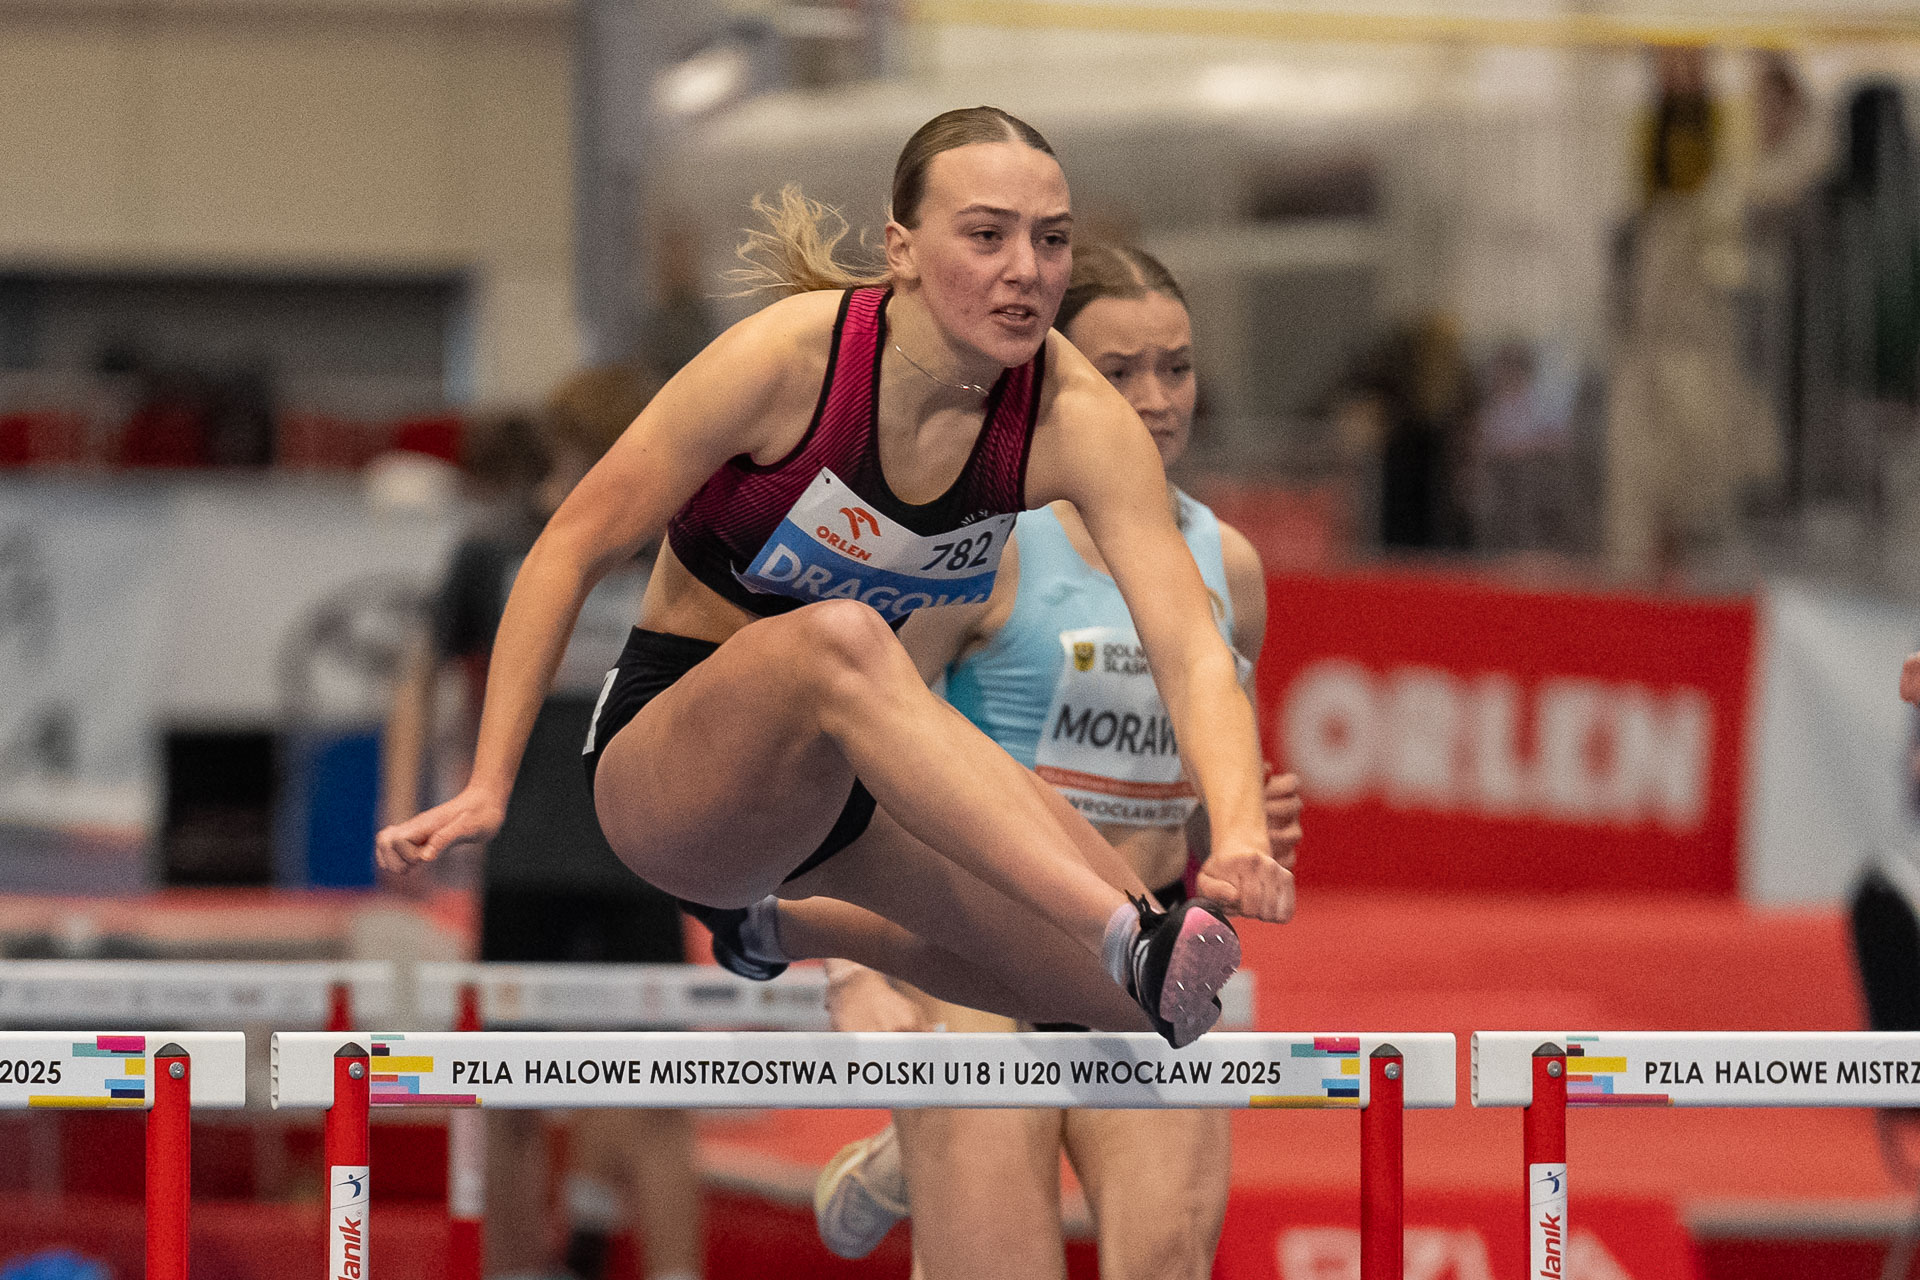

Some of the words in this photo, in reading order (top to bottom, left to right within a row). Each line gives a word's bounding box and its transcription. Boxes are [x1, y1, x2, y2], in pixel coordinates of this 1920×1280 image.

[816, 525, 872, 561] ORLEN
[920, 531, 993, 571] 782
[1281, 658, 1713, 832] ORLEN
[0, 1060, 62, 1084] 2025
[453, 1061, 513, 1085] PZLA
[525, 1060, 641, 1085] HALOWE
[650, 1060, 837, 1085] MISTRZOSTWA
[847, 1061, 934, 1085] POLSKI
[944, 1061, 991, 1085] U18
[999, 1061, 1005, 1085] i
[1014, 1061, 1061, 1086] U20
[1070, 1060, 1213, 1085] WROCŁAW
[1220, 1060, 1281, 1085] 2025
[1645, 1061, 1702, 1084] PZLA
[1715, 1060, 1827, 1084] HALOWE
[1836, 1061, 1920, 1084] MISTRZ
